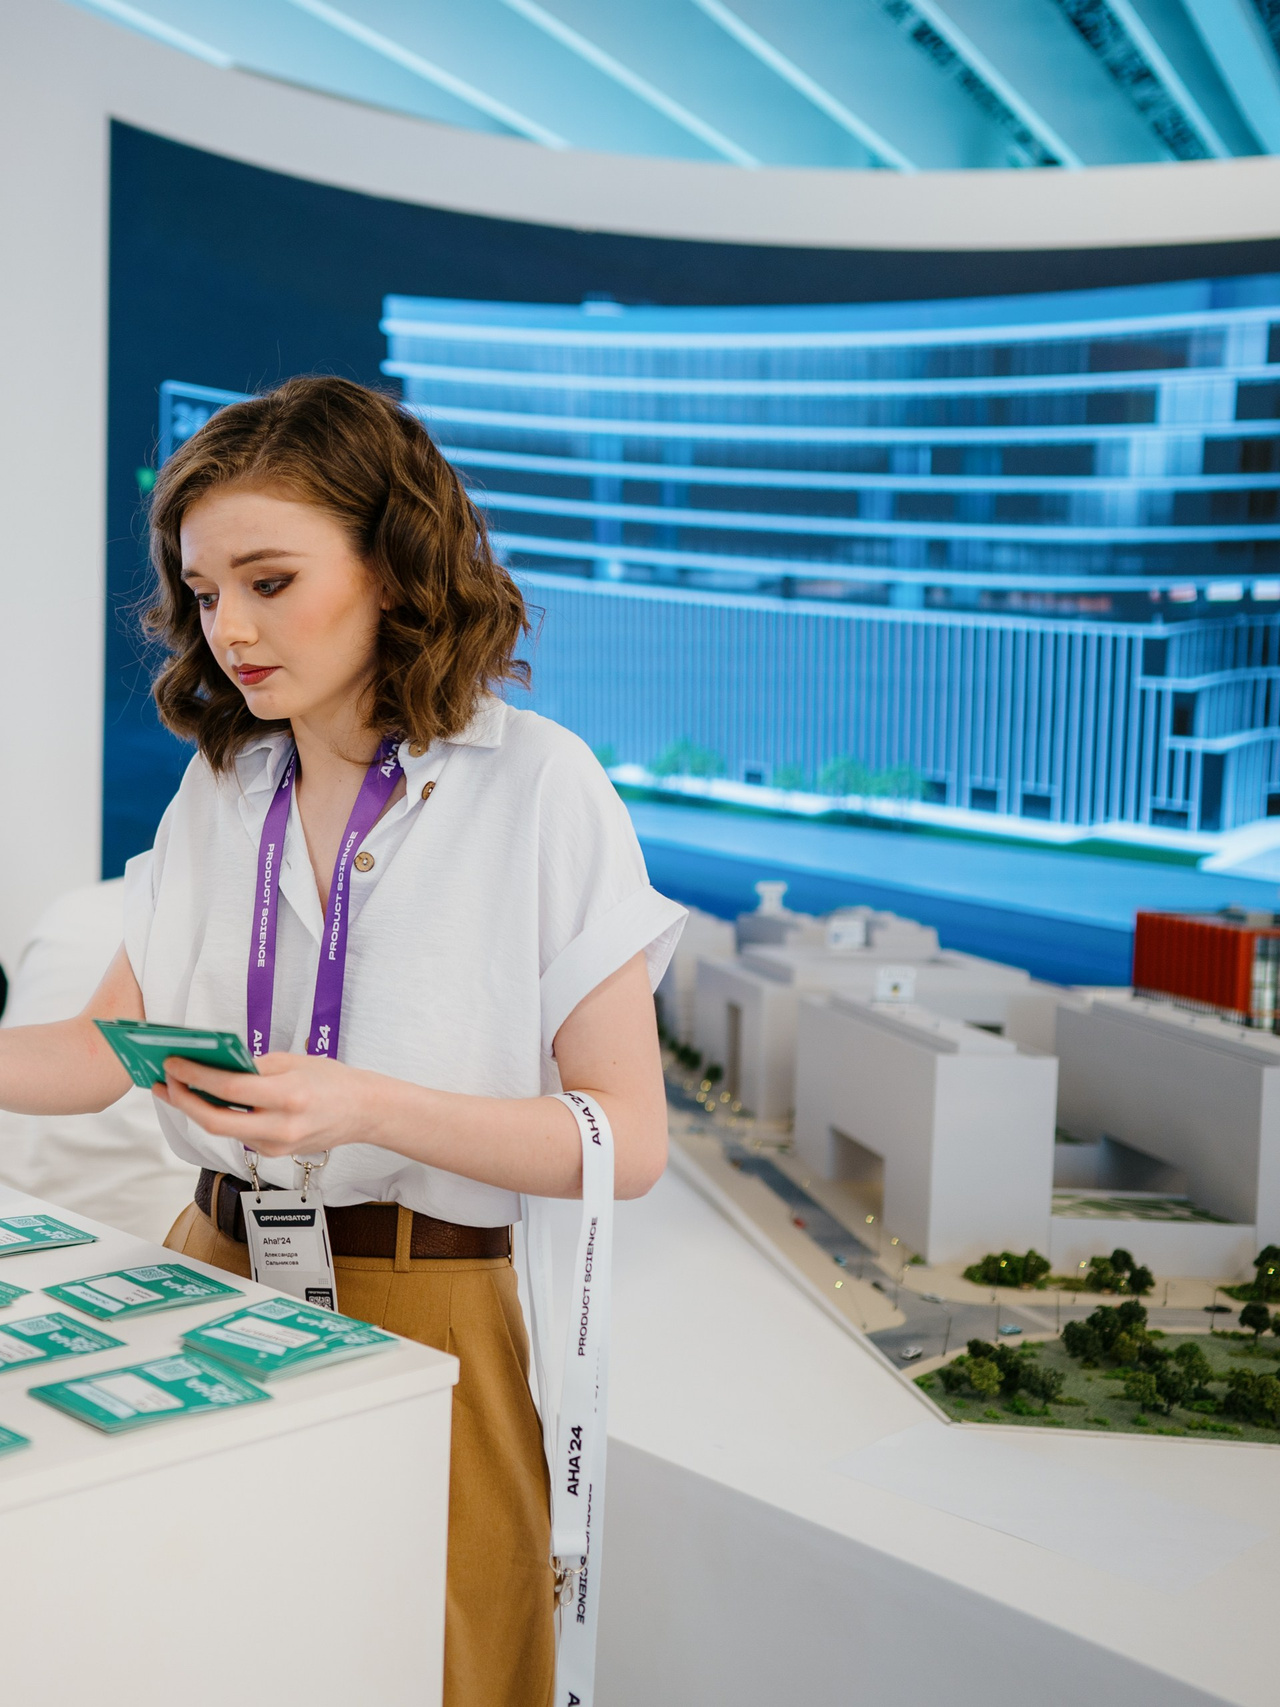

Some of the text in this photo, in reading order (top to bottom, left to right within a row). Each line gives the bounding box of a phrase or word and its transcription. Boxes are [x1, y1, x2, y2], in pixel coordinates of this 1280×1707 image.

[257, 843, 275, 968] PRODUCT SCIENCE
[328, 830, 359, 961] PRODUCT SCIENCE
[253, 1029, 263, 1058] AH
[260, 1214, 312, 1222] ОРГАНИЗАТОР
[578, 1216, 598, 1356] PRODUCT SCIENCE
